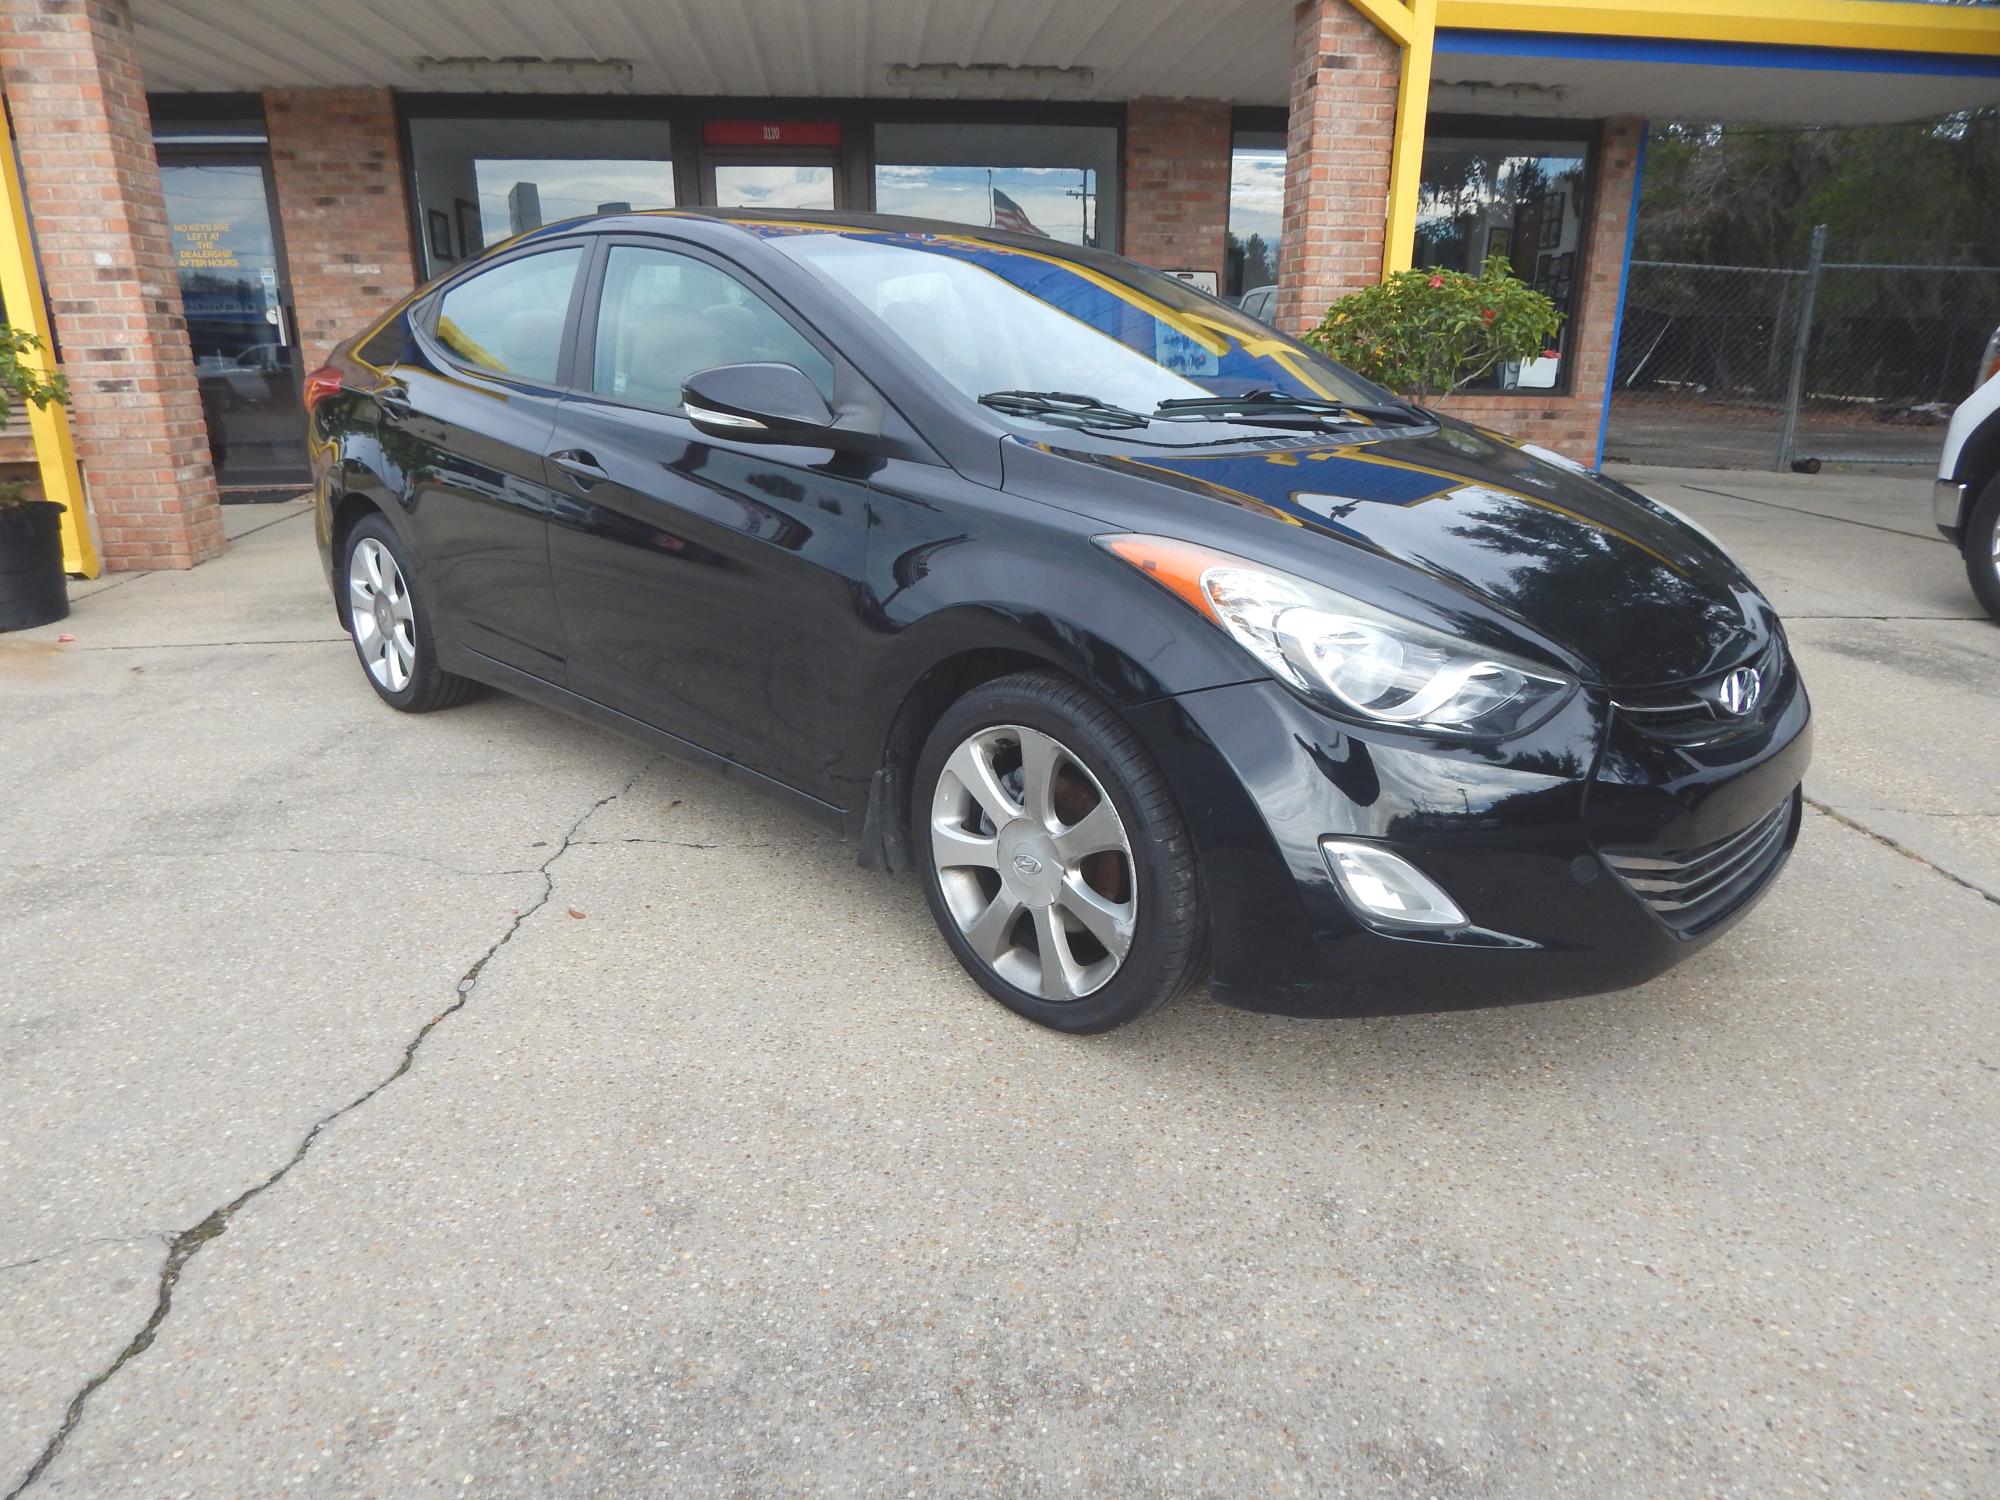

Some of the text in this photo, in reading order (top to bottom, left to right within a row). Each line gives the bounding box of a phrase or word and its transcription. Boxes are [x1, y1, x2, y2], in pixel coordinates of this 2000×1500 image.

[174, 224, 187, 232] NO
[213, 224, 231, 232] ARE
[187, 232, 220, 240] LEFT AT
[197, 241, 214, 249] THE
[180, 250, 233, 258] DEALERSHIP
[179, 259, 239, 267] AFTER HOURS
